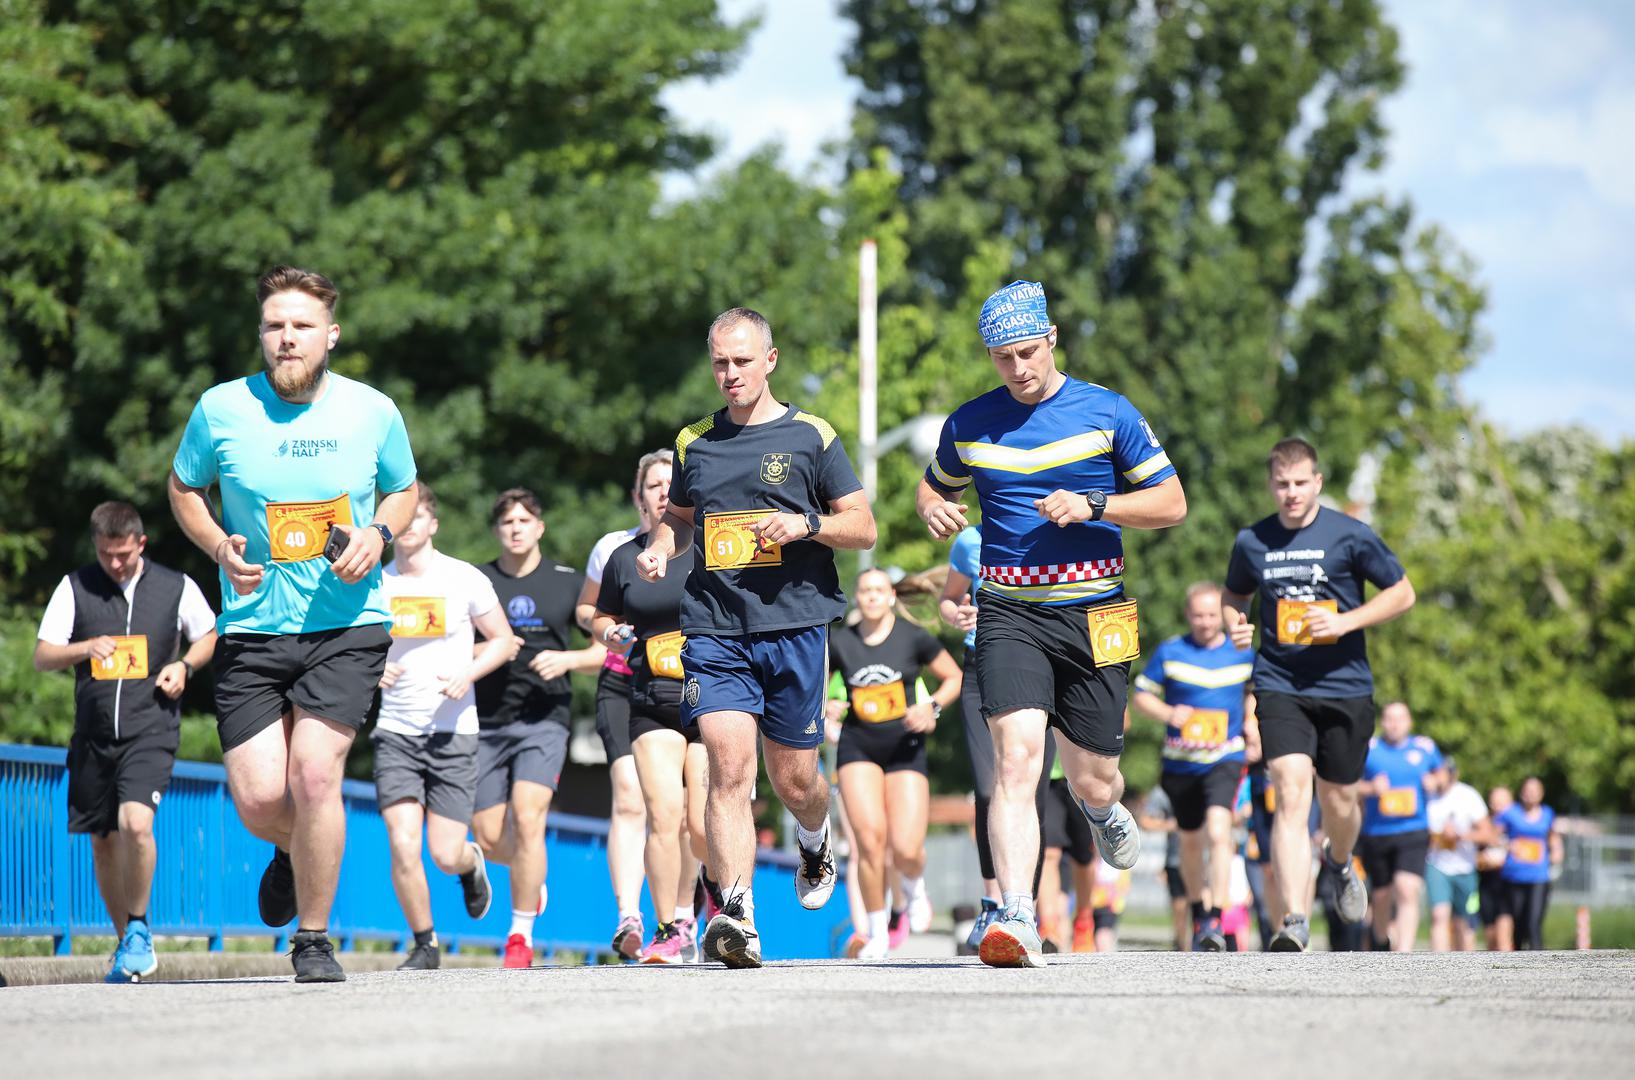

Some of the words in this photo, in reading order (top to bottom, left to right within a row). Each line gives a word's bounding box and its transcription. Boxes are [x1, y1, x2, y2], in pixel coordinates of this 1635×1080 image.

[292, 439, 338, 449] ZRINSKI
[292, 448, 320, 458] HALF
[285, 530, 306, 548] 40
[717, 540, 734, 556] 51
[1103, 631, 1122, 651] 74
